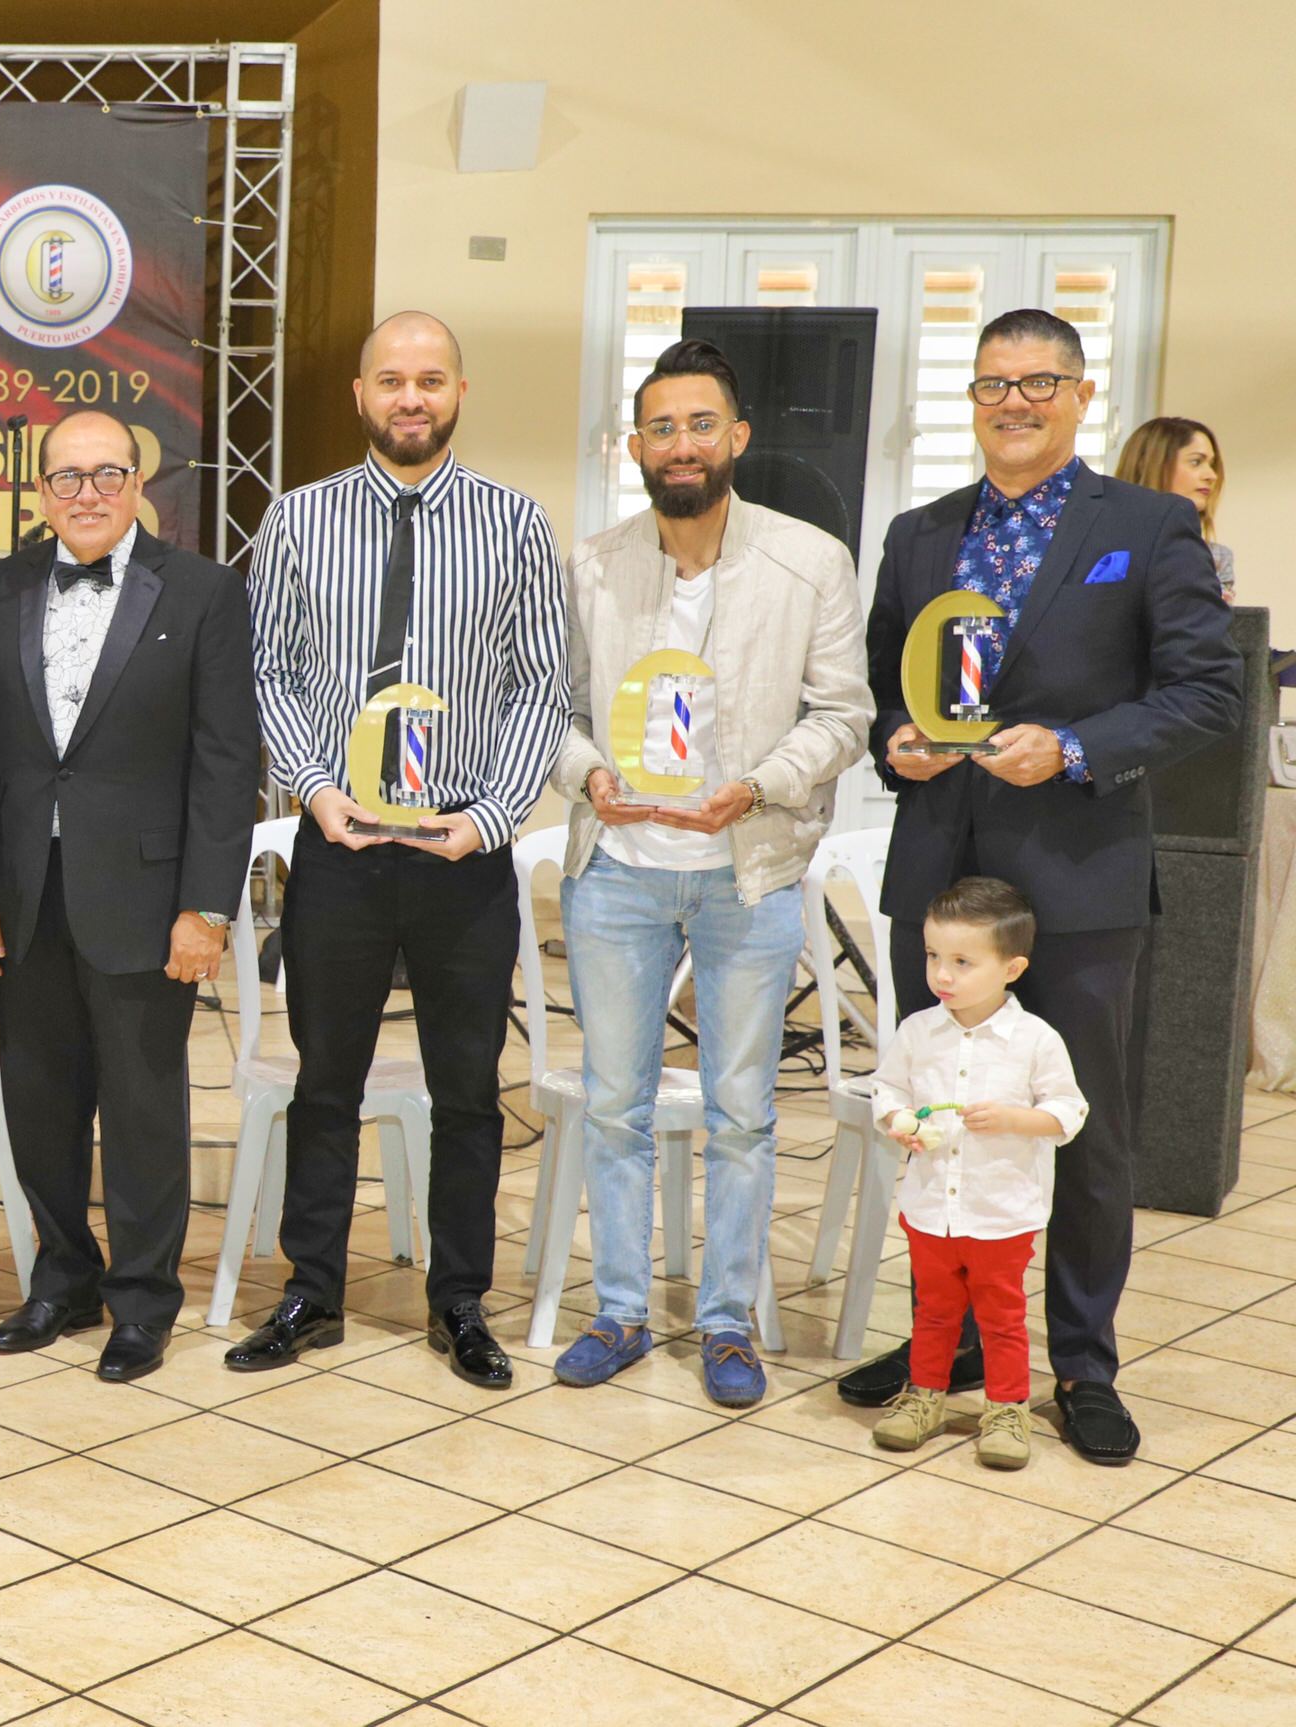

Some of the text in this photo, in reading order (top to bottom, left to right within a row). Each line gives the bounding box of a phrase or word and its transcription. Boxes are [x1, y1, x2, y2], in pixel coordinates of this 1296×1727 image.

[48, 191, 56, 200] Y
[59, 191, 113, 229] ESTILISTAS
[17, 324, 92, 343] PUERTO RICO
